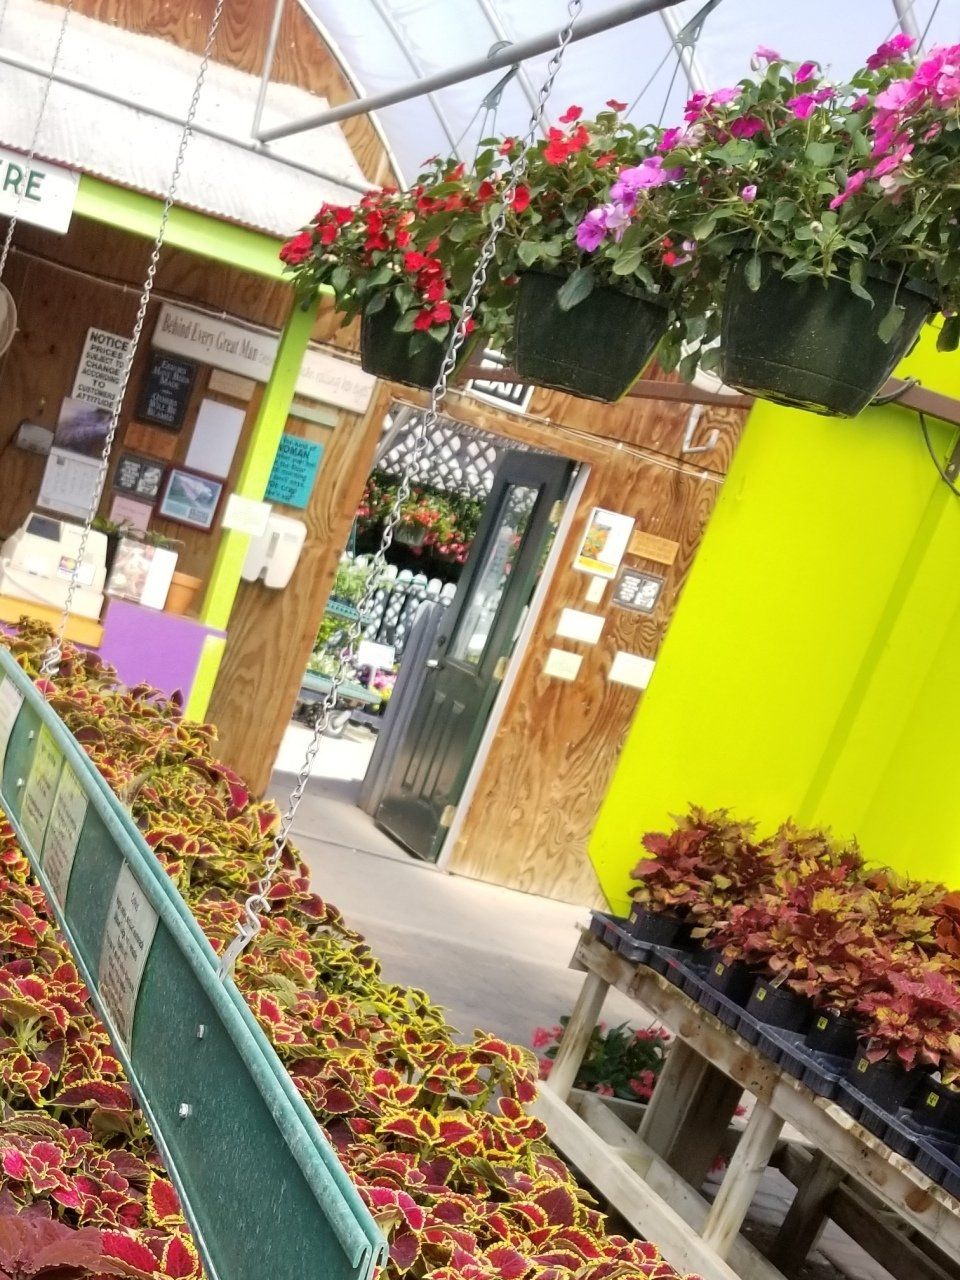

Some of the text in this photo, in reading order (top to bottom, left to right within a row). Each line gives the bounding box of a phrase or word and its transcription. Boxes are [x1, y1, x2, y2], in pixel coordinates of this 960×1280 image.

[90, 332, 129, 351] NOTICE
[161, 313, 191, 339] Behind
[191, 322, 215, 347] Every
[216, 331, 240, 353] Great
[240, 339, 258, 361] Man
[86, 352, 124, 368] SUBJECT TO
[91, 345, 123, 359] PRICES
[86, 360, 121, 375] CHANGE
[93, 380, 106, 388] TO
[75, 392, 114, 408] ATTITUDE
